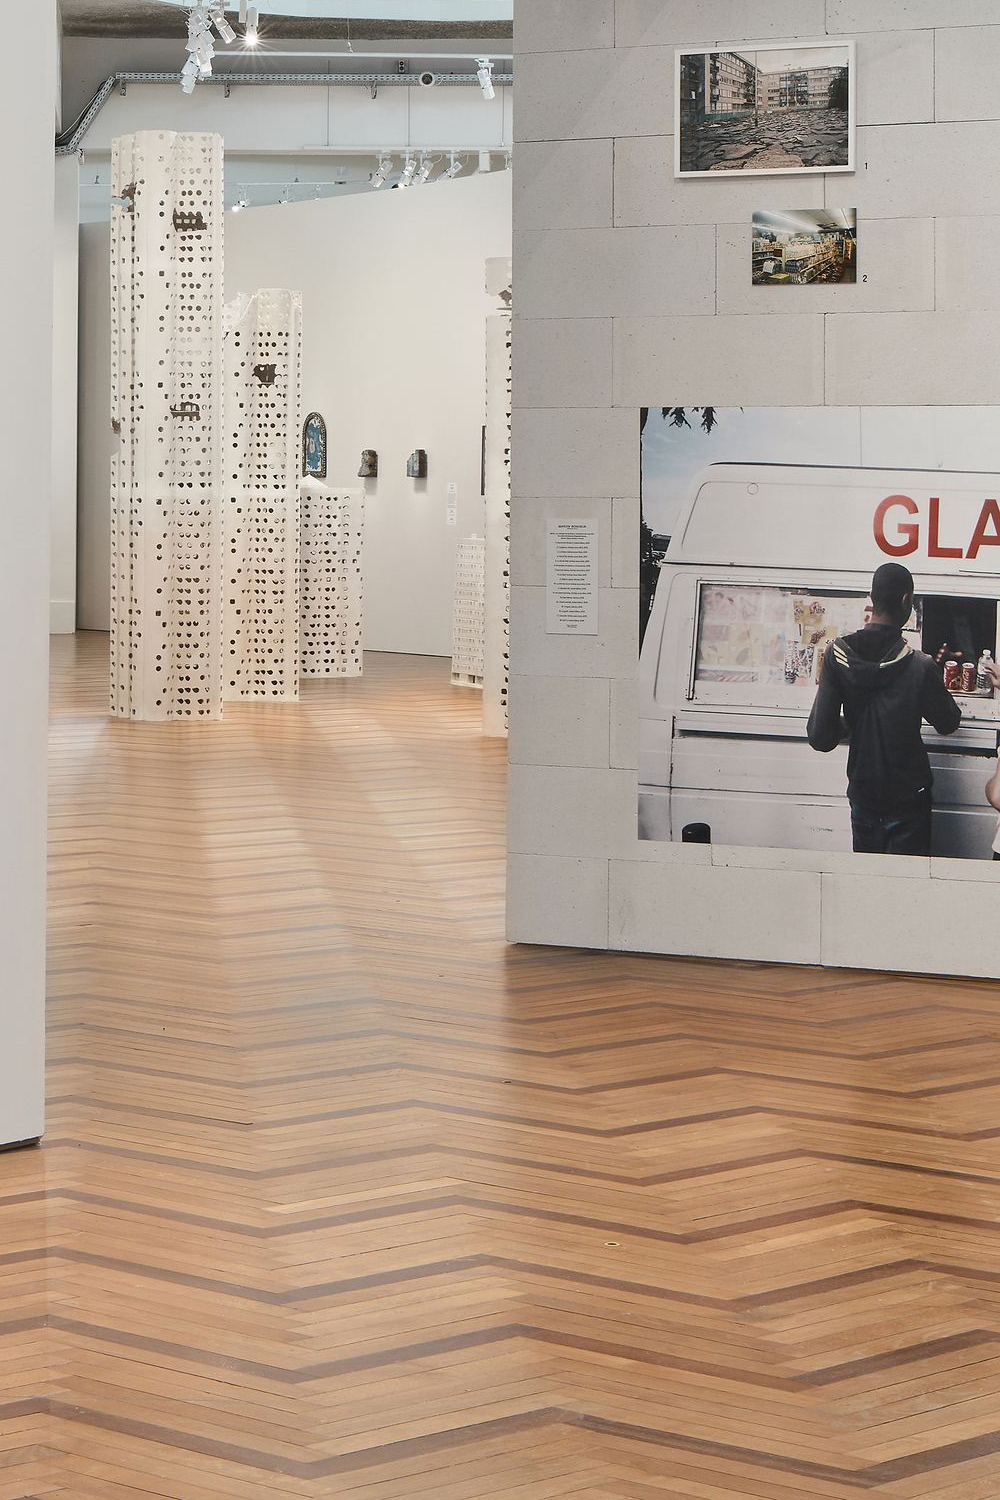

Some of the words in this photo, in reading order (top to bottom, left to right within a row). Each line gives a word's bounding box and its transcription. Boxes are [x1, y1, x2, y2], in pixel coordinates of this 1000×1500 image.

[864, 162, 868, 170] 1
[862, 275, 868, 283] 2
[873, 494, 1000, 560] GLA
